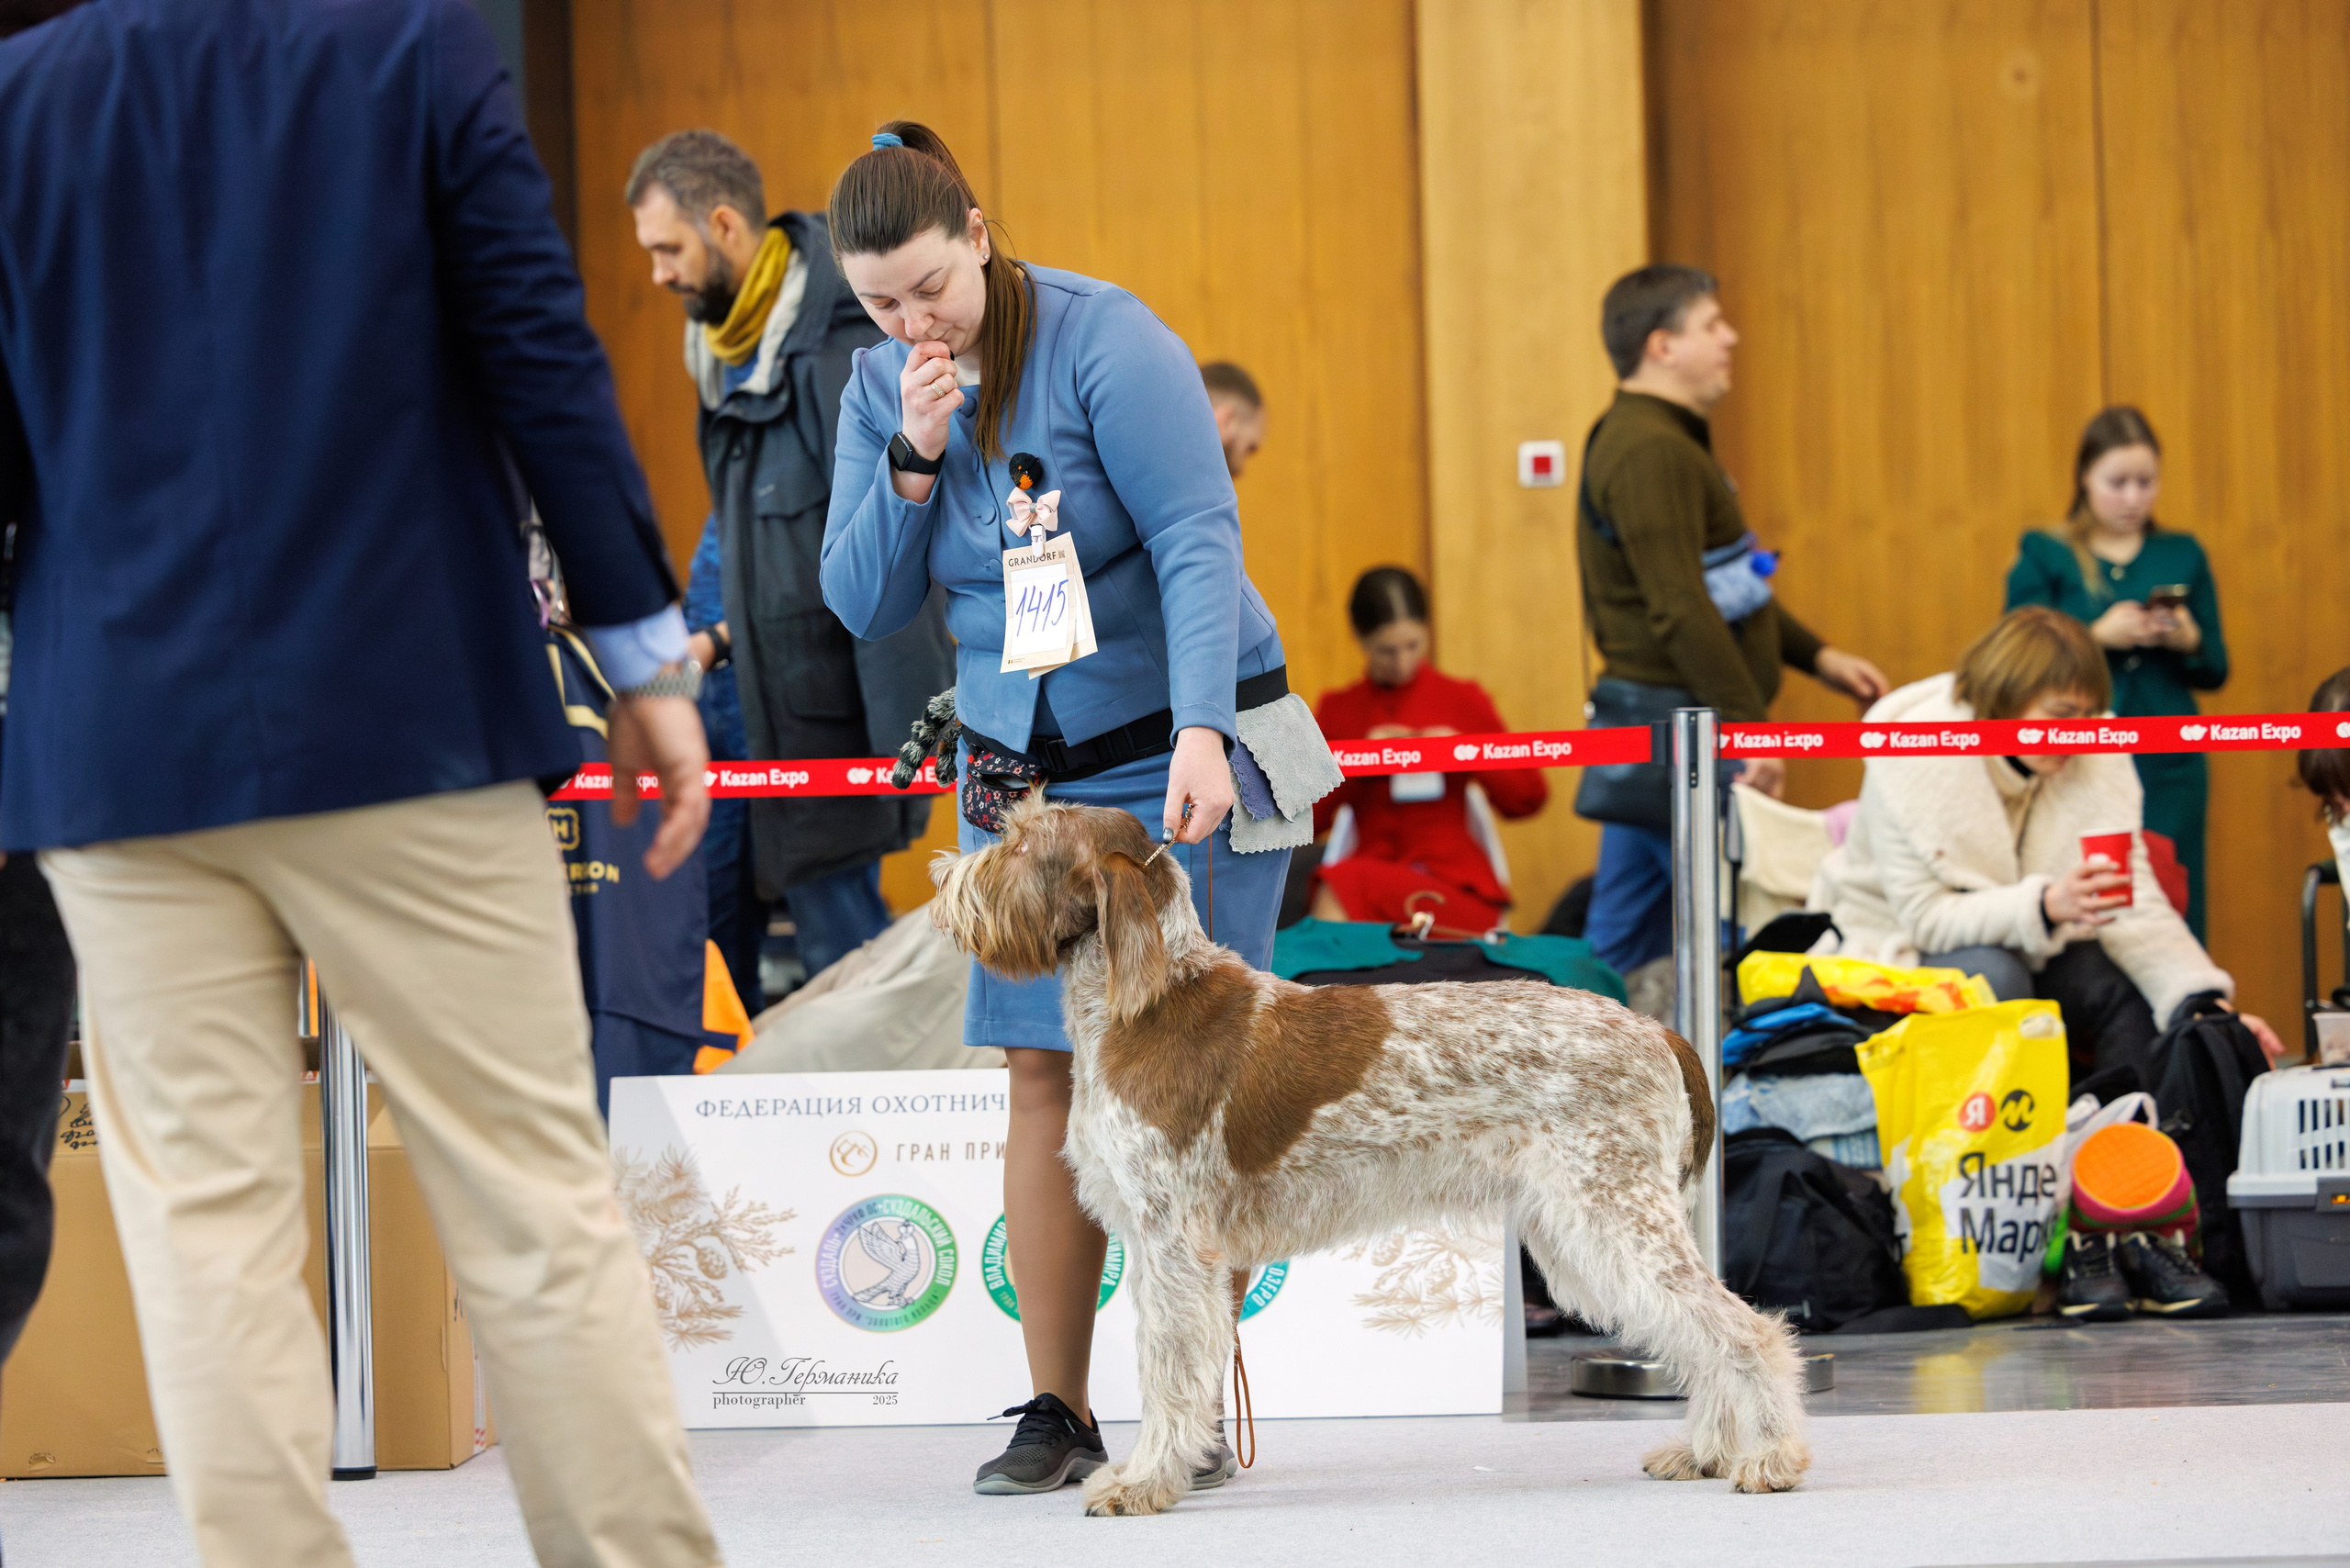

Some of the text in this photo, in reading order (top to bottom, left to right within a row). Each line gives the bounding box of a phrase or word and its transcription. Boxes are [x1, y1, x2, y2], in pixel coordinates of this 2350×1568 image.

[1008, 551, 1057, 567] GRANDORF
[1015, 578, 1069, 637] 1415
[1733, 732, 1824, 751] Kazan Expo
[1889, 731, 1981, 750] Kazan Expo
[2047, 727, 2139, 747] Kazan Expo
[2210, 722, 2301, 743] Kazan Expo
[1334, 747, 1422, 768] Kazan Expo
[1483, 740, 1572, 760] Kazan Expo
[635, 776, 659, 792] xpo
[720, 769, 809, 790] Kazan Expo
[876, 767, 923, 784] Kan
[696, 1093, 1006, 1119] ФЕДЕРАЦИЯ ОХОТНИЧ
[896, 1141, 1005, 1162] ГРАН ПРИ
[1959, 1152, 2057, 1207] Янде
[1960, 1207, 2045, 1264] Мар
[820, 1238, 840, 1288] СУЗДАЛЬ
[934, 1249, 955, 1287] СОКОЛ
[1250, 1267, 1285, 1307] ОЗЕРО
